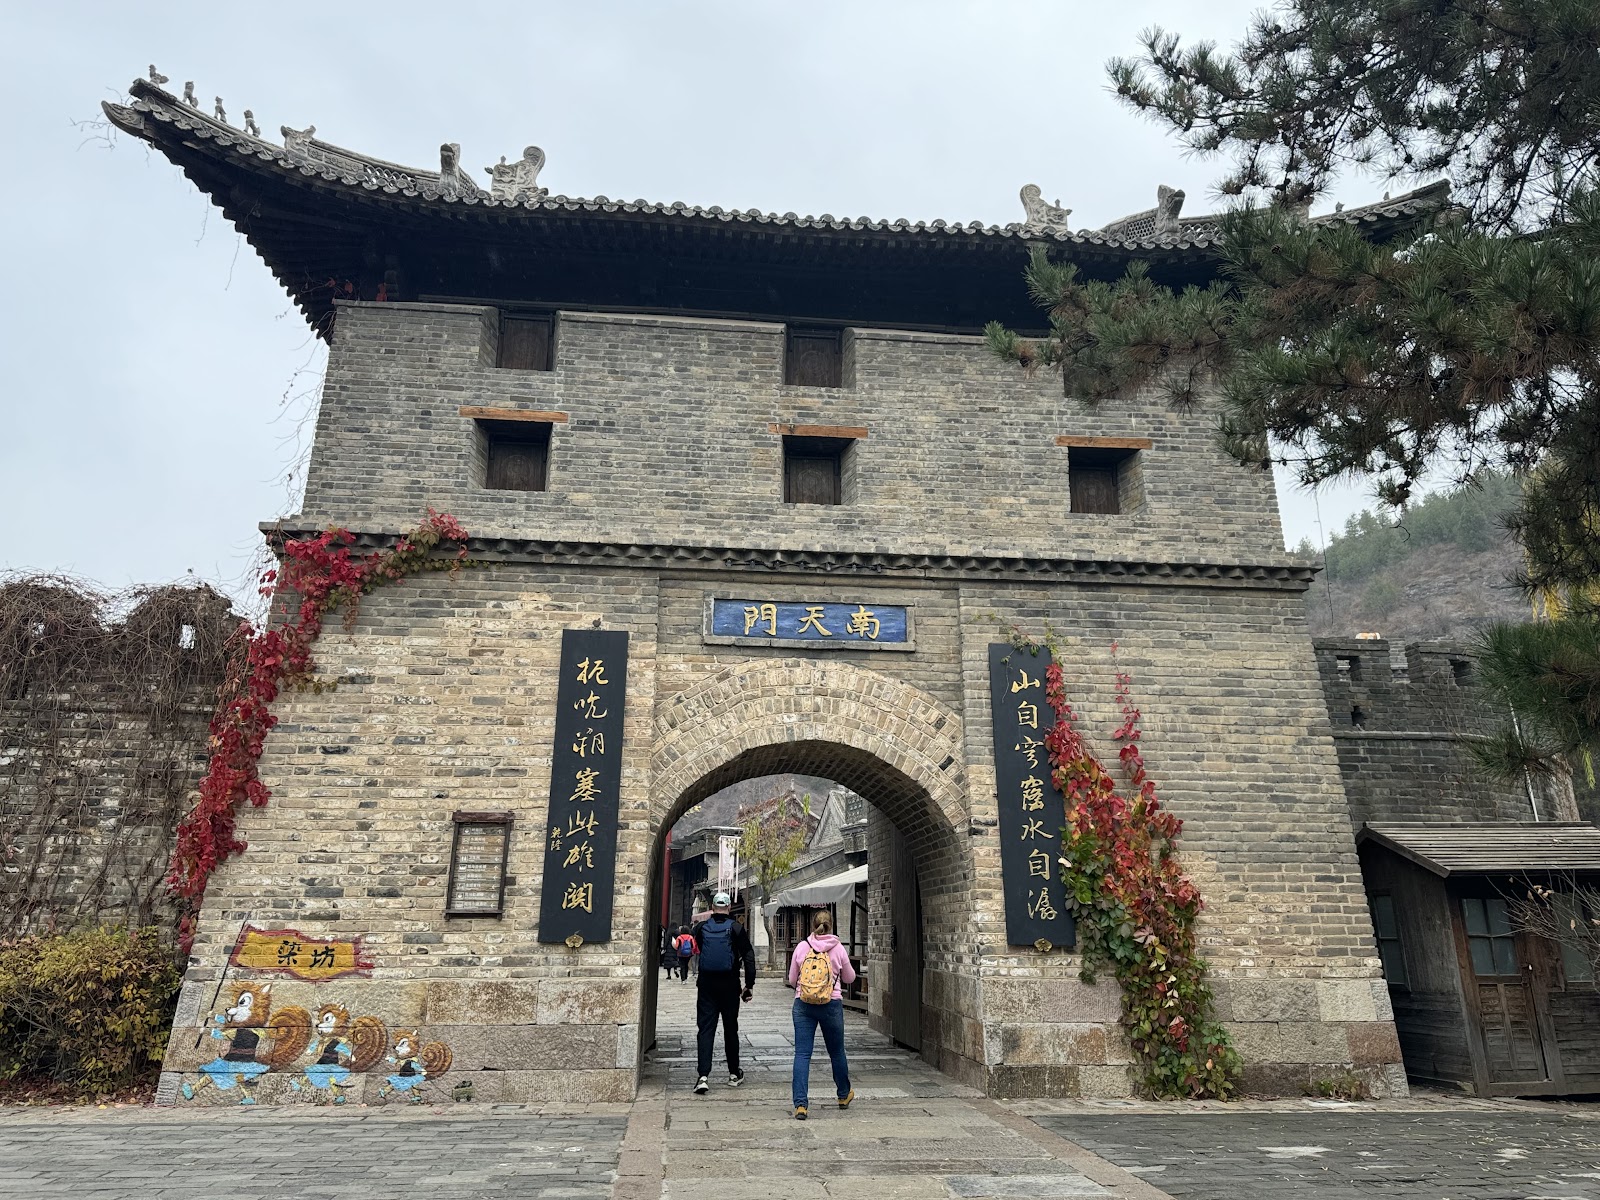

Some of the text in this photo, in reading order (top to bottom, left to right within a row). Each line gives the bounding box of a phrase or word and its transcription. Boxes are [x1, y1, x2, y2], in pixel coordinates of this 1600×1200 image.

[743, 603, 881, 640] 南天門
[277, 940, 336, 969] 染坊
